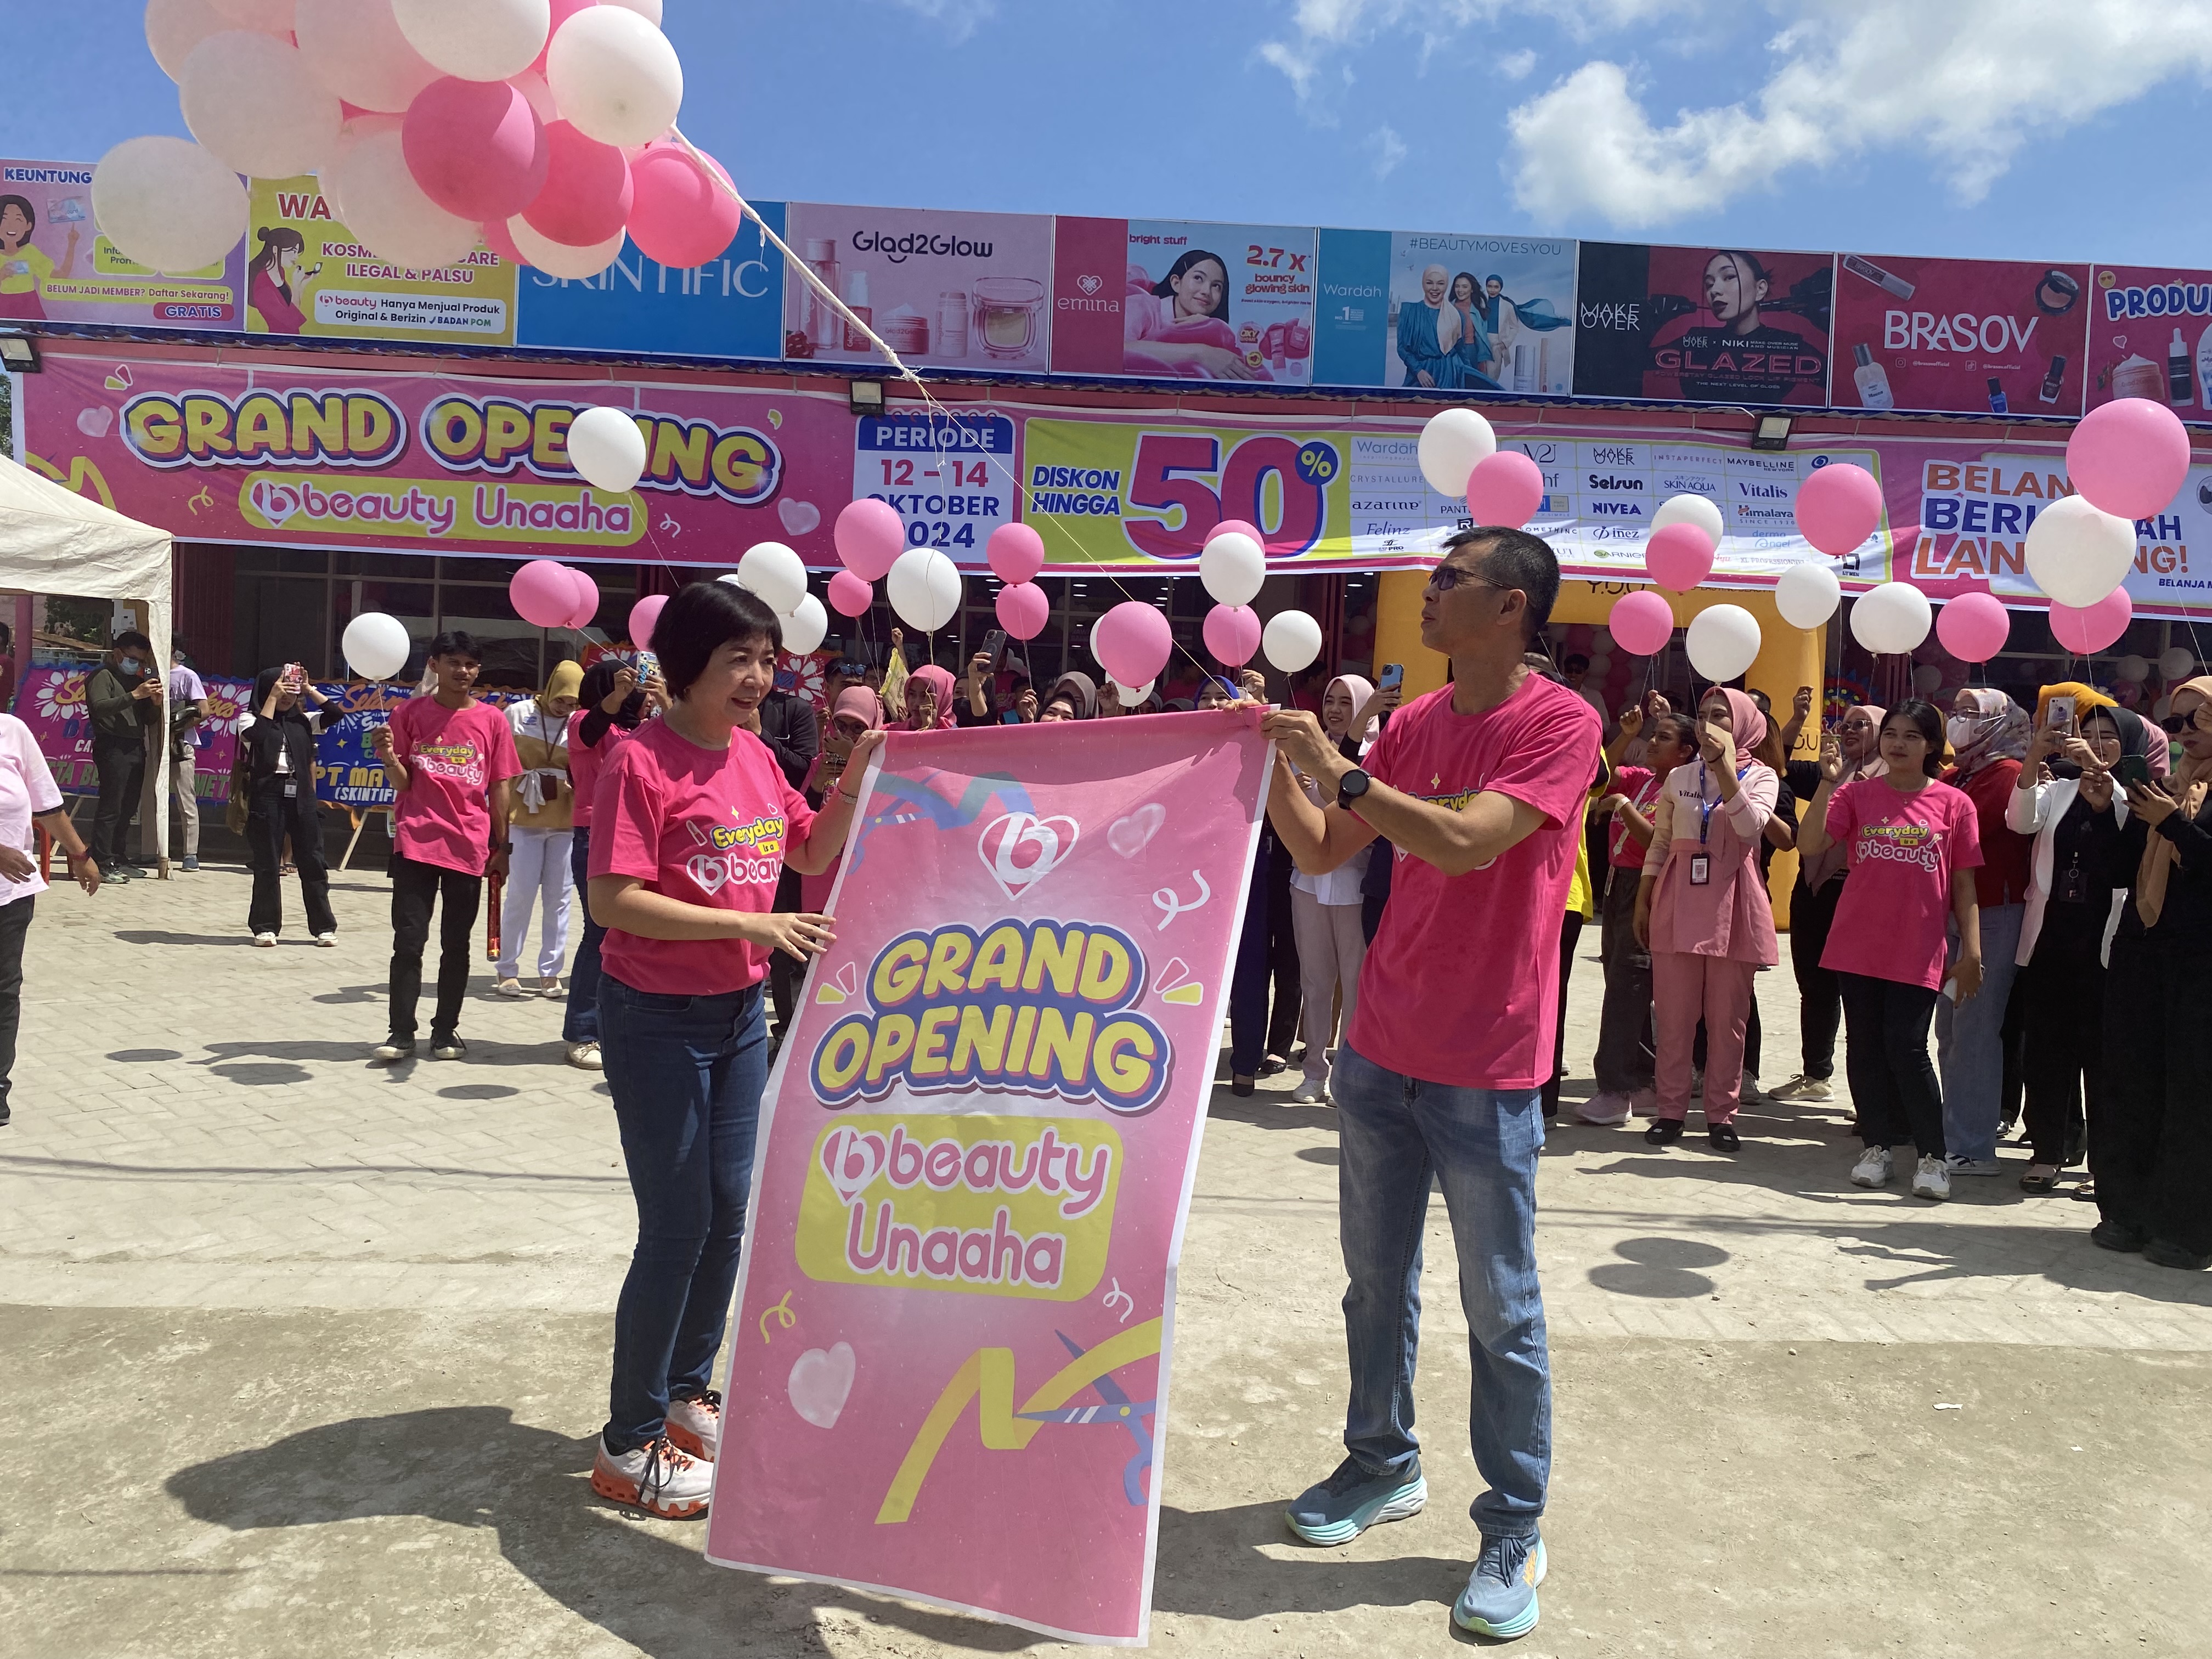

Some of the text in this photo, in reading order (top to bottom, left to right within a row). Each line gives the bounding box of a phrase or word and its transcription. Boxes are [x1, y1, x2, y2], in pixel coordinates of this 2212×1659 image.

[4, 168, 93, 184] KEUNTUNG
[279, 194, 331, 219] WA
[853, 230, 993, 258] Glad2Glow
[1129, 234, 1188, 246] bright stuff
[457, 251, 499, 266] ARE
[1246, 244, 1285, 268] 2.7
[347, 263, 473, 283] ILEGAL & PALSU
[1255, 273, 1296, 284] bouncy
[47, 284, 229, 302] BELUM JADI MEMBER? Daftar Sekarang!
[1245, 283, 1310, 295] glowing skin
[336, 295, 500, 314] beauty Hanya Menjual Produk
[1058, 297, 1120, 313] emina
[1580, 302, 1640, 320] MAKE
[2107, 285, 2212, 319] PRODU
[166, 306, 222, 318] GRATIS
[335, 309, 491, 327] Original & Berizin BADAN POM
[1342, 306, 1350, 321] 1
[1581, 312, 1640, 331] OVER
[1884, 309, 2039, 353] BRASOV
[1722, 339, 1749, 348] NIKI
[1655, 349, 1822, 375] GLAZED
[123, 392, 402, 462] GRAND
[425, 397, 774, 495] OPEING
[876, 426, 995, 449] PERIODE
[1593, 447, 1634, 458] MAKE
[1594, 454, 1635, 465] OVER
[1654, 454, 1723, 465] INSTAPERFECT
[1727, 458, 1795, 469] MAYBELLINE
[881, 459, 989, 488] 12 14
[1032, 466, 1120, 491] DISKON
[1350, 475, 1424, 483] CRYSTALLURE
[1589, 474, 1644, 490] Selsun
[1927, 463, 2074, 500] BELAN
[1664, 480, 1717, 492] SKIN AQUA
[1739, 482, 1788, 498] Vitalis
[302, 481, 456, 536] beauty
[476, 486, 630, 533] Unaaha
[1031, 492, 1121, 516] HINGGA
[1440, 505, 1471, 514] PANT
[1592, 502, 1642, 515] NIVEA
[1737, 505, 1794, 518] Himalaya
[904, 521, 975, 549] 024
[1366, 521, 1411, 535] Felinz
[1612, 528, 1640, 538] inez
[2159, 578, 2205, 589] BELANJA
[419, 743, 476, 758] Everyday
[426, 757, 484, 786] beauty
[712, 816, 785, 848] Everyday
[1862, 824, 1929, 839] Everyday
[1869, 839, 1940, 872] beauty
[871, 923, 1136, 1006] GRAND
[814, 1002, 1161, 1097] OPENING
[888, 1127, 1108, 1215] beauty
[848, 1201, 1063, 1285] Unaaha
